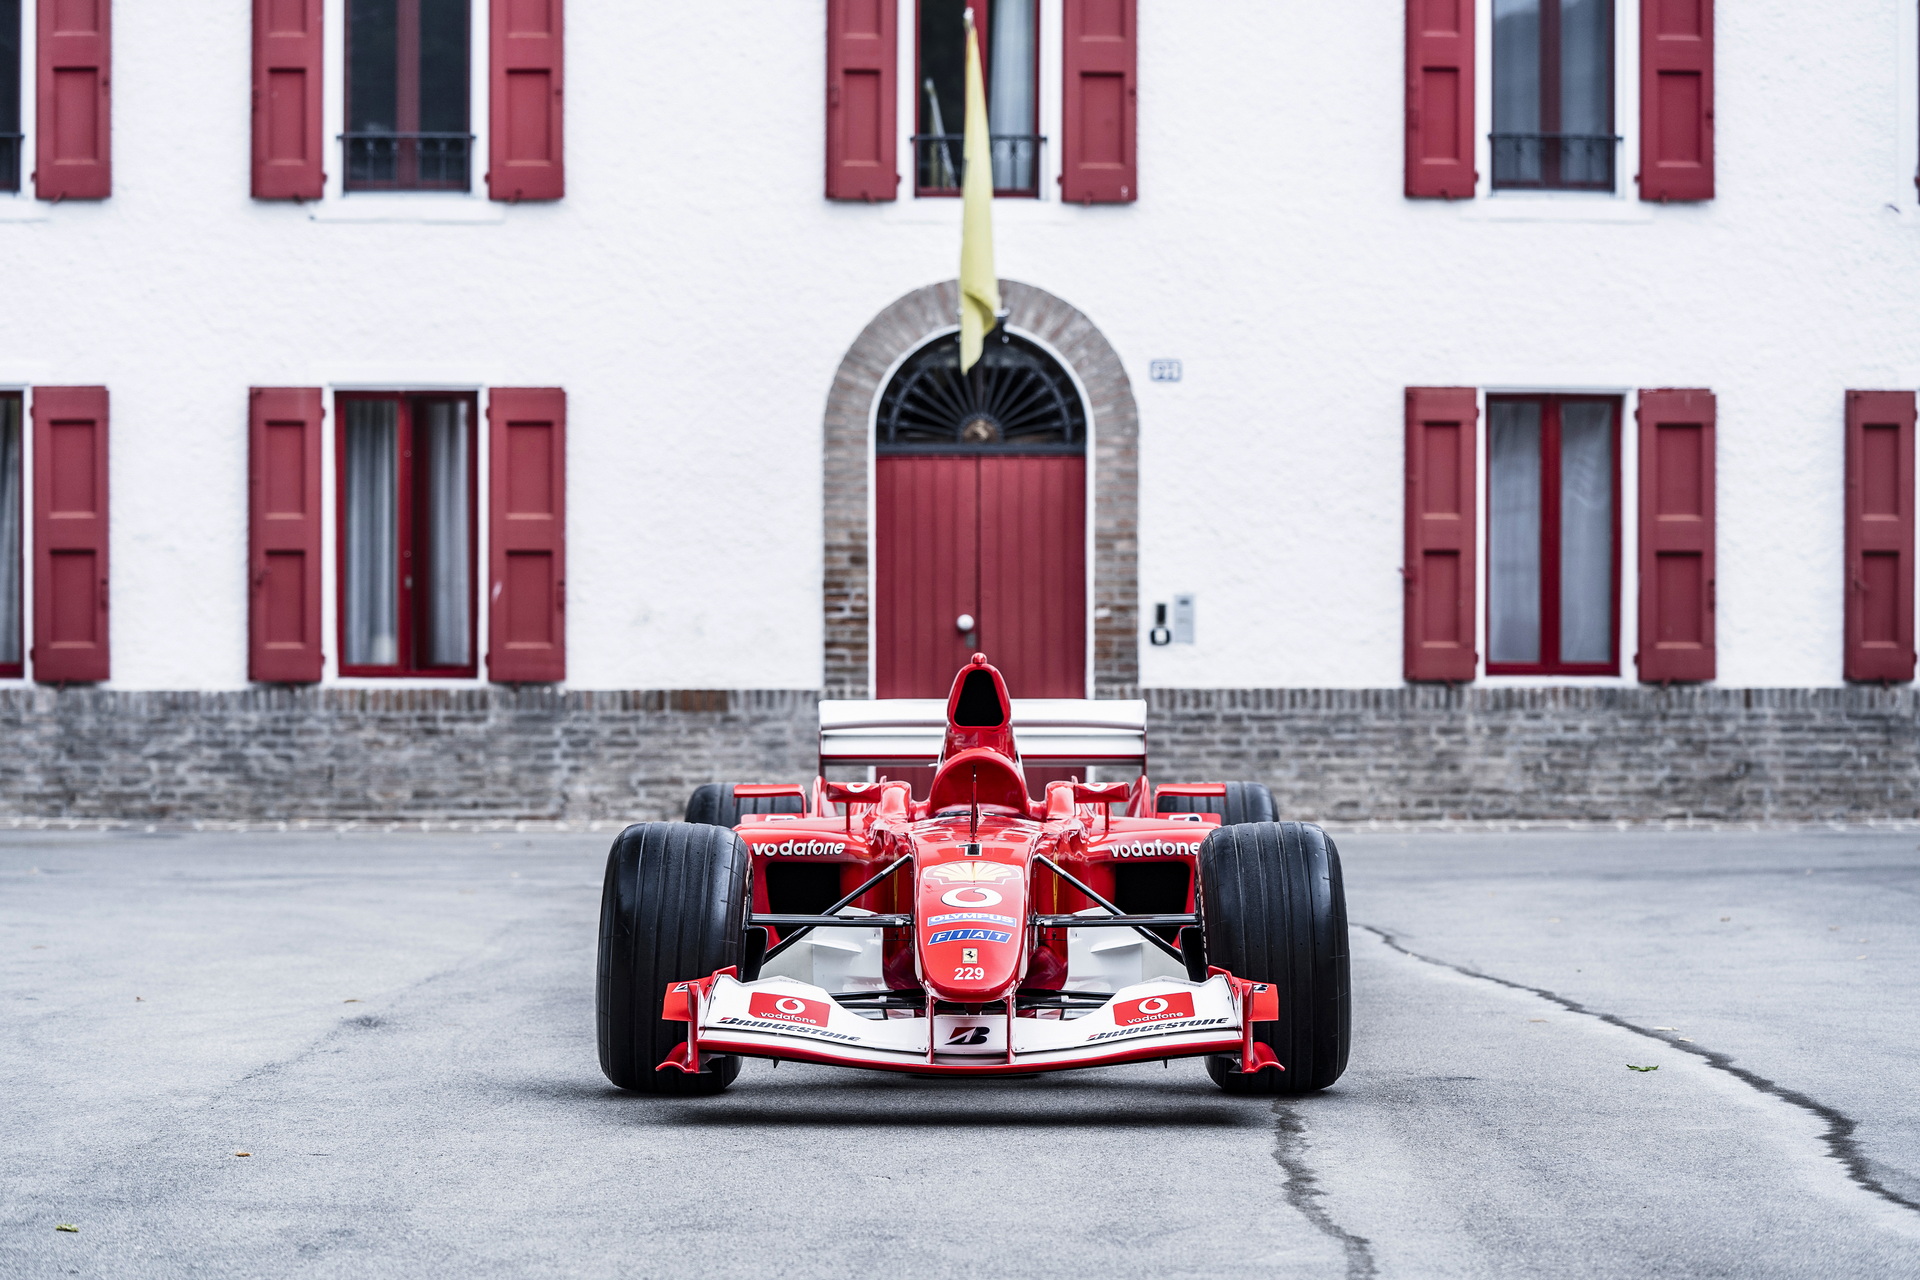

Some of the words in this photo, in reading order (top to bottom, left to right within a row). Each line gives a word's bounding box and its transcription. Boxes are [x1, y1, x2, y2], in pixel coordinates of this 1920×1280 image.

[752, 839, 846, 856] vodafone
[1108, 838, 1201, 857] vodafone
[930, 913, 1014, 924] OLYMPUS
[935, 930, 1007, 942] FIAT
[954, 967, 984, 980] 229
[760, 1011, 817, 1025] vodafone
[1126, 1011, 1184, 1024] vodafone
[716, 1017, 861, 1041] BRIDGESTONE
[1086, 1017, 1228, 1041] BRIDGESTONE
